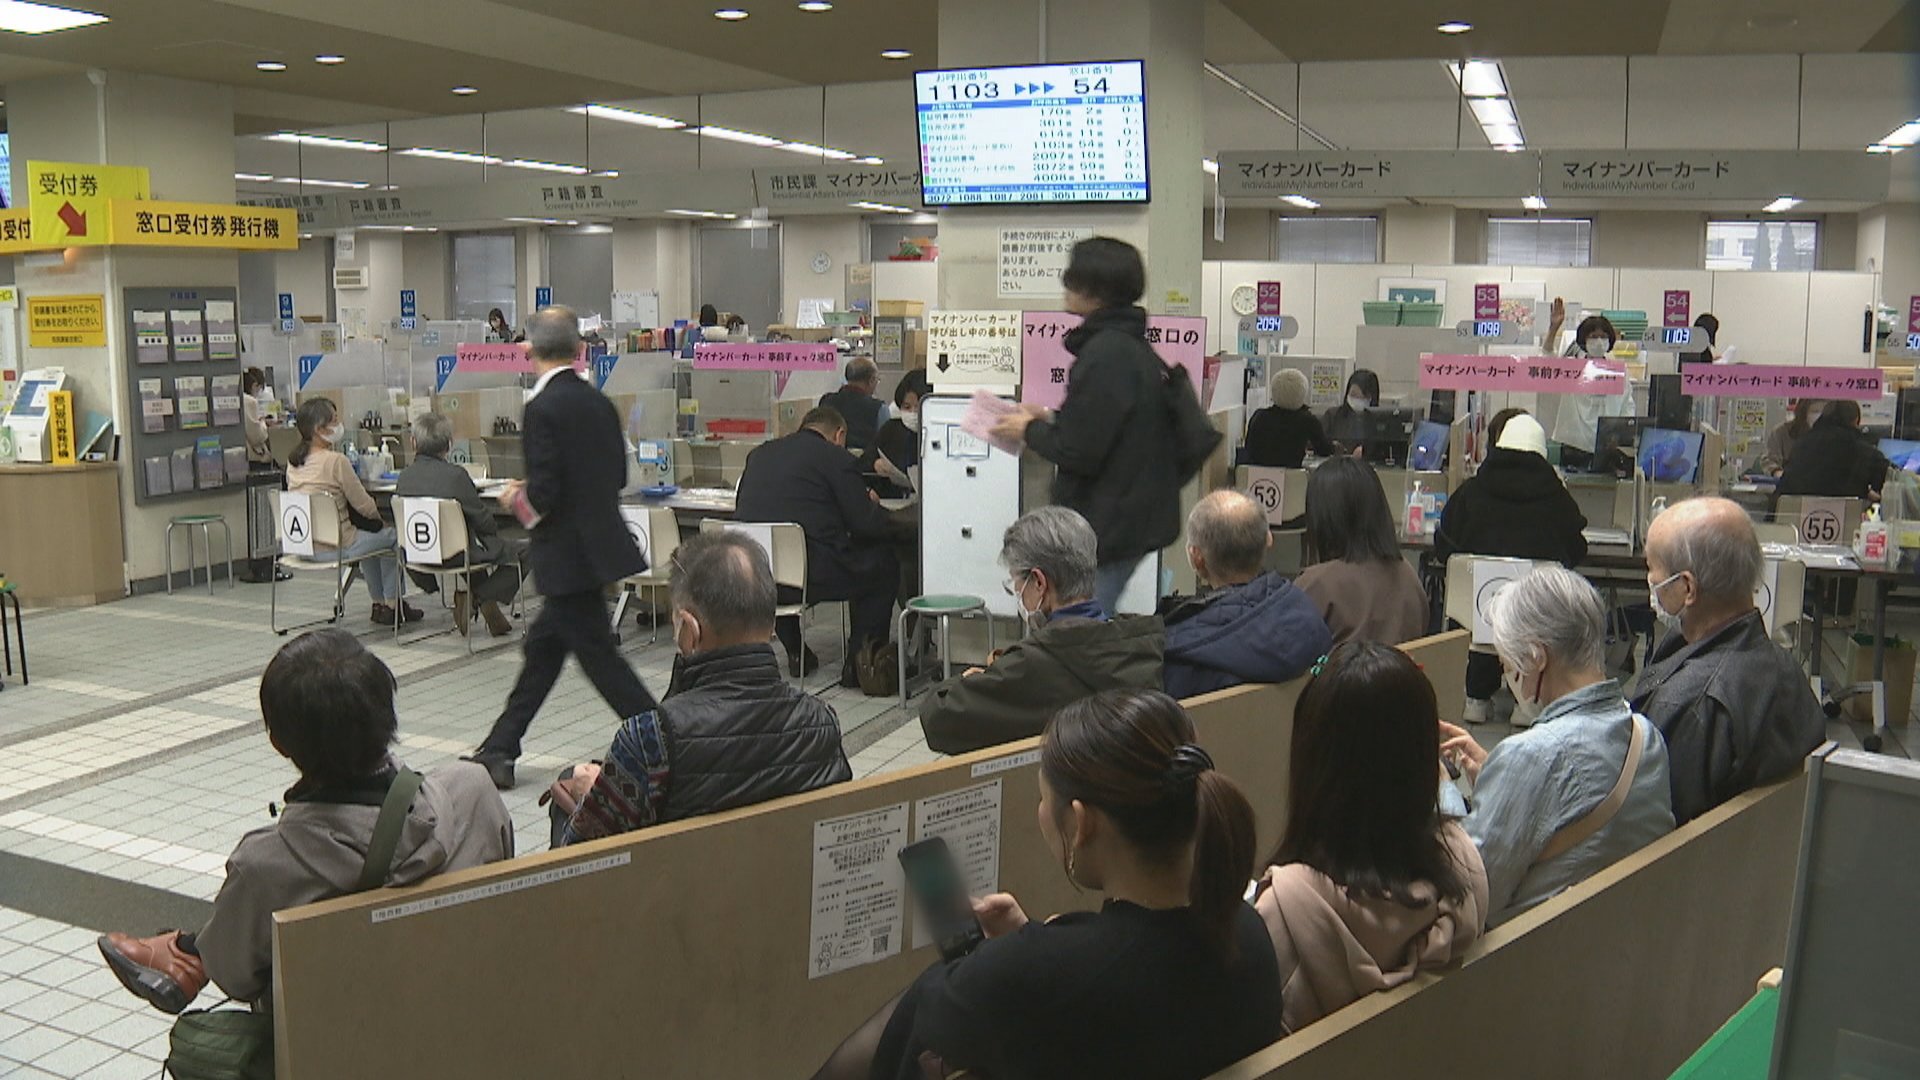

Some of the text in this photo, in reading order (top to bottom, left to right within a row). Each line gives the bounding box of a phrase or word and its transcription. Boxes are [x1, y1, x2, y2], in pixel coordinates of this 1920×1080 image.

[929, 77, 1110, 100] 1103 54
[1239, 161, 1391, 177] マイナンバーカード
[1563, 161, 1729, 178] マイナンバーカード
[39, 173, 98, 196] 受付券
[770, 174, 818, 190] 市民課
[1342, 180, 1363, 189] Card
[1563, 181, 1695, 191] Individual(My)Number Card
[0, 217, 31, 240] 受付
[136, 210, 280, 239] 窓口受付券発行機
[1002, 255, 1038, 265] あります。
[1002, 281, 1022, 290] さい。
[1259, 285, 1279, 298] 52
[403, 292, 414, 303] 10
[1477, 288, 1497, 301] 53
[1666, 294, 1688, 308] 54
[930, 314, 1018, 325] マイナンバーカード
[930, 327, 1017, 337] 呼び出し中の番号は
[1146, 326, 1199, 345] 窓口の
[1665, 328, 1690, 344] 1103
[931, 340, 957, 350] こちら
[460, 352, 517, 361] マイナンバーカード
[695, 352, 765, 362] マイナンバーカード
[301, 360, 311, 373] 11
[439, 360, 450, 375] 12
[600, 361, 610, 376] 13
[1425, 364, 1516, 378] マイナンバーカード
[1050, 367, 1065, 383] 窓
[1684, 374, 1879, 389] マイナンバーカード 事前チェック窓口
[1255, 486, 1276, 508] 53
[290, 515, 303, 537] A
[414, 522, 430, 544] B
[1808, 517, 1834, 540] 55
